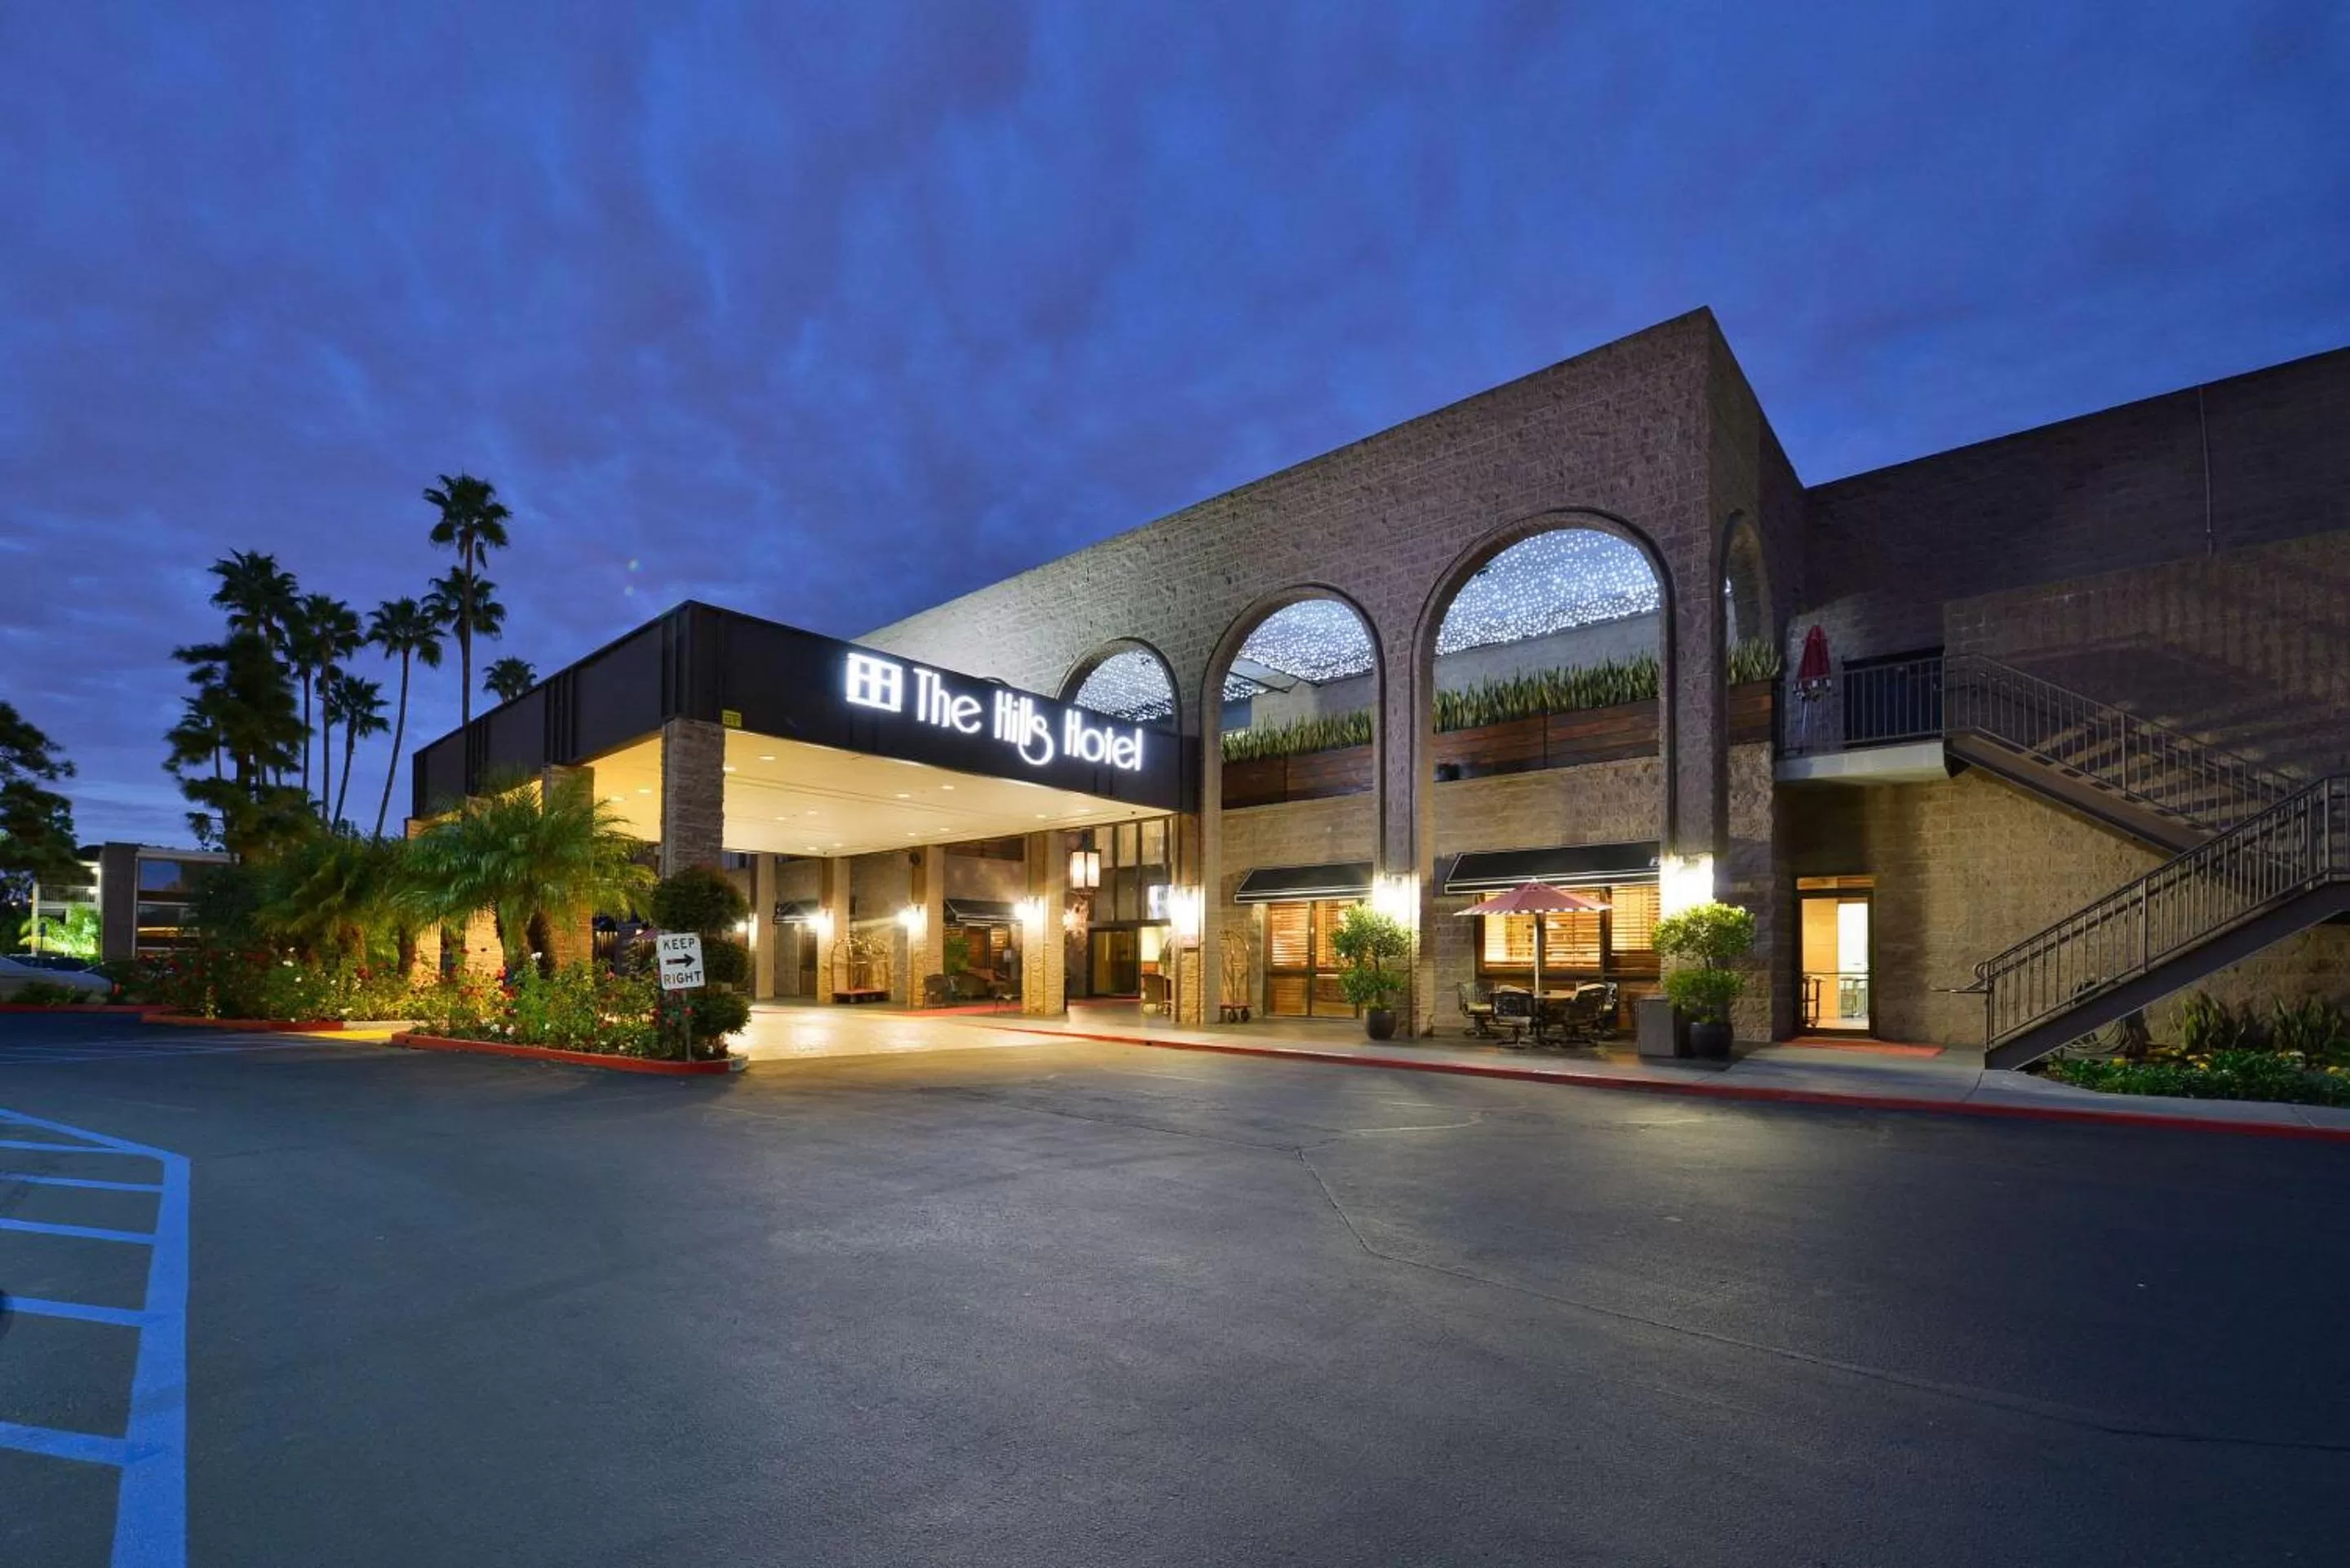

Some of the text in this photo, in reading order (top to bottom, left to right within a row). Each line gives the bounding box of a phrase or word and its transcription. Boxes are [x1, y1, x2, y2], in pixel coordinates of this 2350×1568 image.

[913, 667, 1144, 771] The Hills Hotel
[663, 937, 695, 950] KEEP
[663, 971, 702, 985] RIGHT
